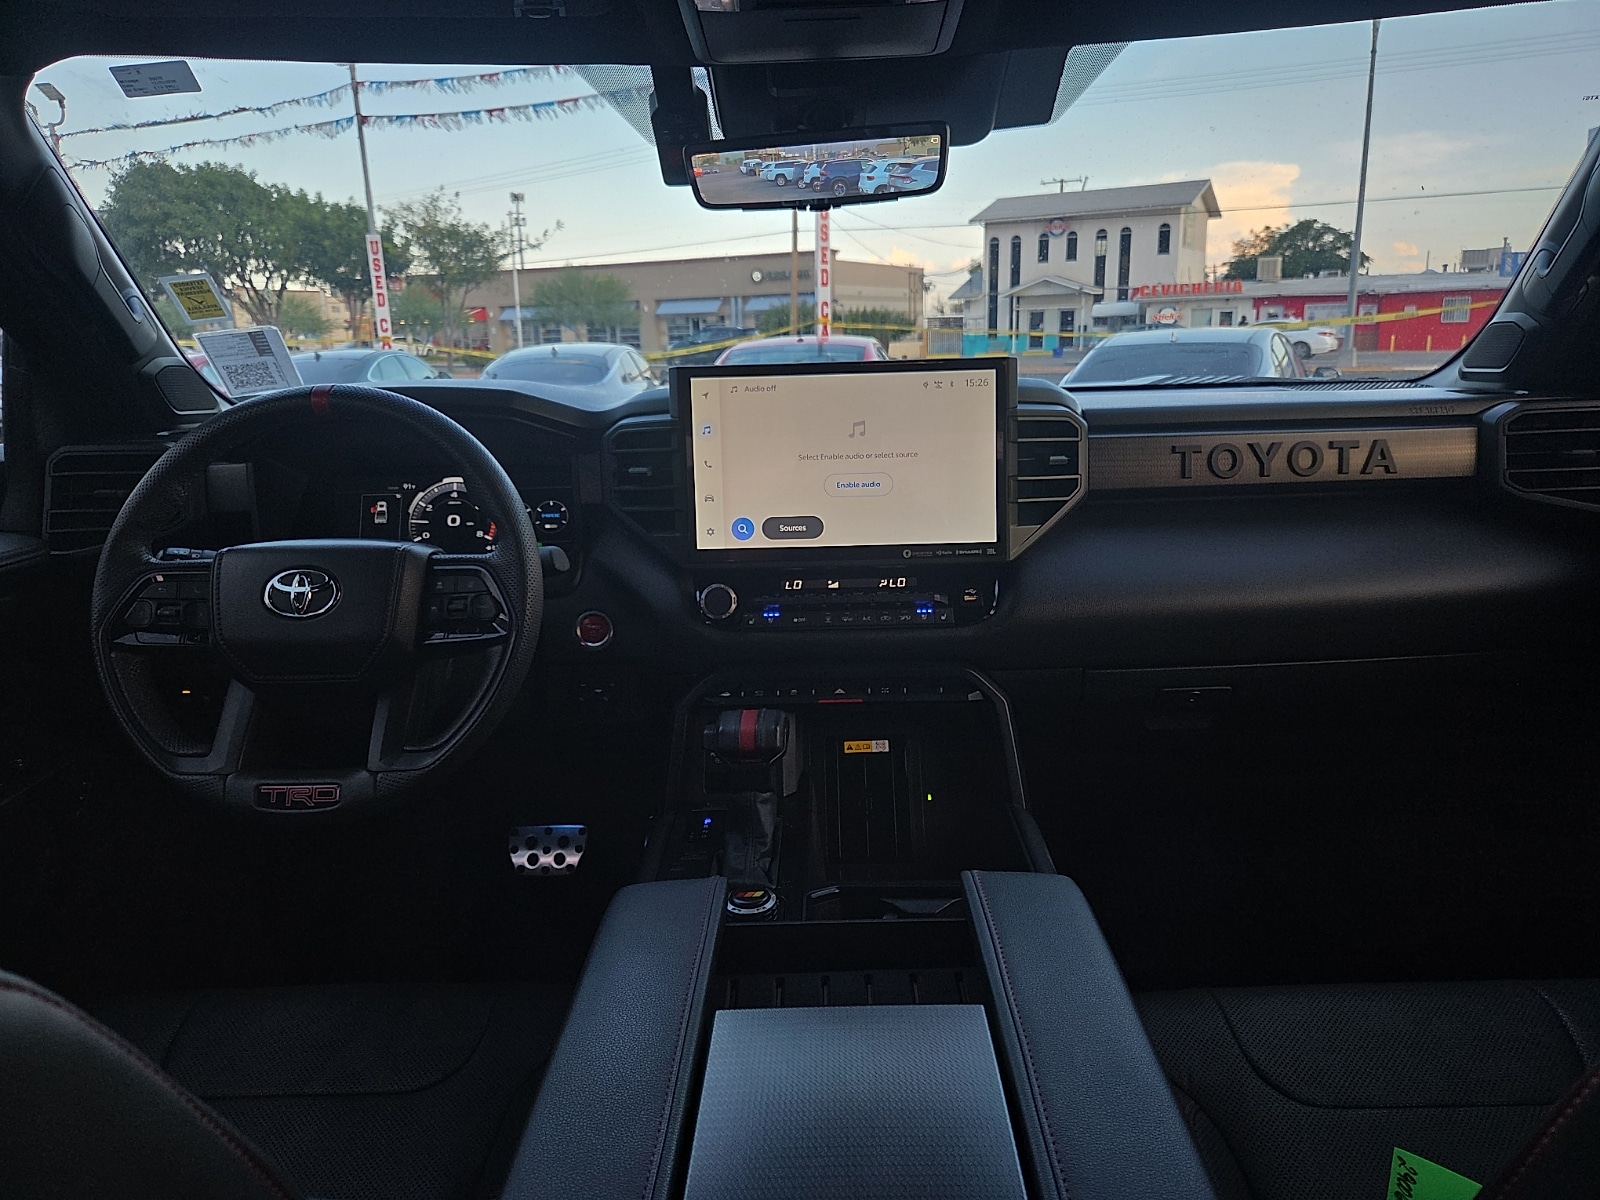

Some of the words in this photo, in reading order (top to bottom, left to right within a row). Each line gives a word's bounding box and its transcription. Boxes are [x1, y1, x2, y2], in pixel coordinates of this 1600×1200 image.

[370, 240, 386, 308] USED
[1139, 278, 1243, 298] CEVICHERIA
[964, 378, 989, 388] 15:26
[744, 384, 762, 393] Audio
[762, 384, 777, 392] off
[798, 453, 819, 461] Select
[820, 452, 843, 460] Enable
[845, 452, 865, 460] audio
[1171, 438, 1398, 480] TOYOTA
[836, 481, 860, 489] Enable
[861, 481, 881, 489] audio
[779, 524, 807, 533] Sources
[476, 530, 484, 538] 8
[785, 580, 803, 590] LO
[889, 577, 906, 587] LO
[260, 785, 340, 806] TRD
